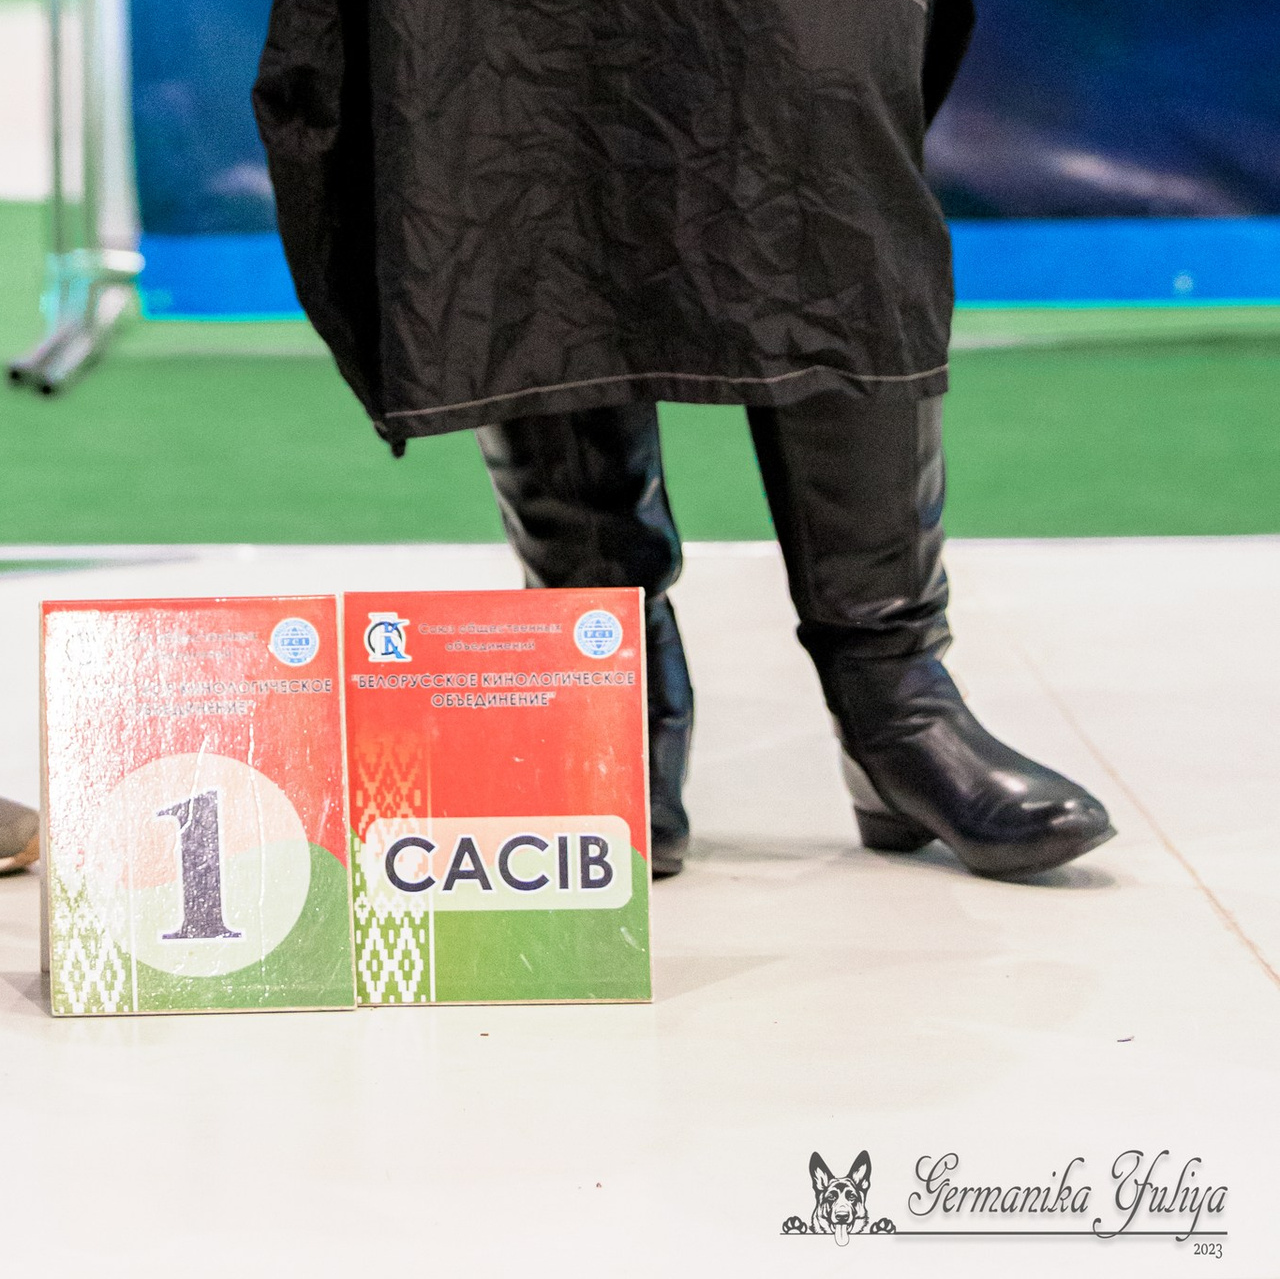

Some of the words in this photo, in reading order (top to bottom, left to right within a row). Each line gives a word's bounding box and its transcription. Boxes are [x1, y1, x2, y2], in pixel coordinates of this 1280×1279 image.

[418, 623, 456, 635] Союз
[458, 622, 562, 635] общественных
[445, 639, 536, 652] объединений
[481, 671, 635, 688] КИНОЛОГИЧЕСКОЕ
[155, 790, 243, 940] 1
[384, 834, 615, 893] CACIB
